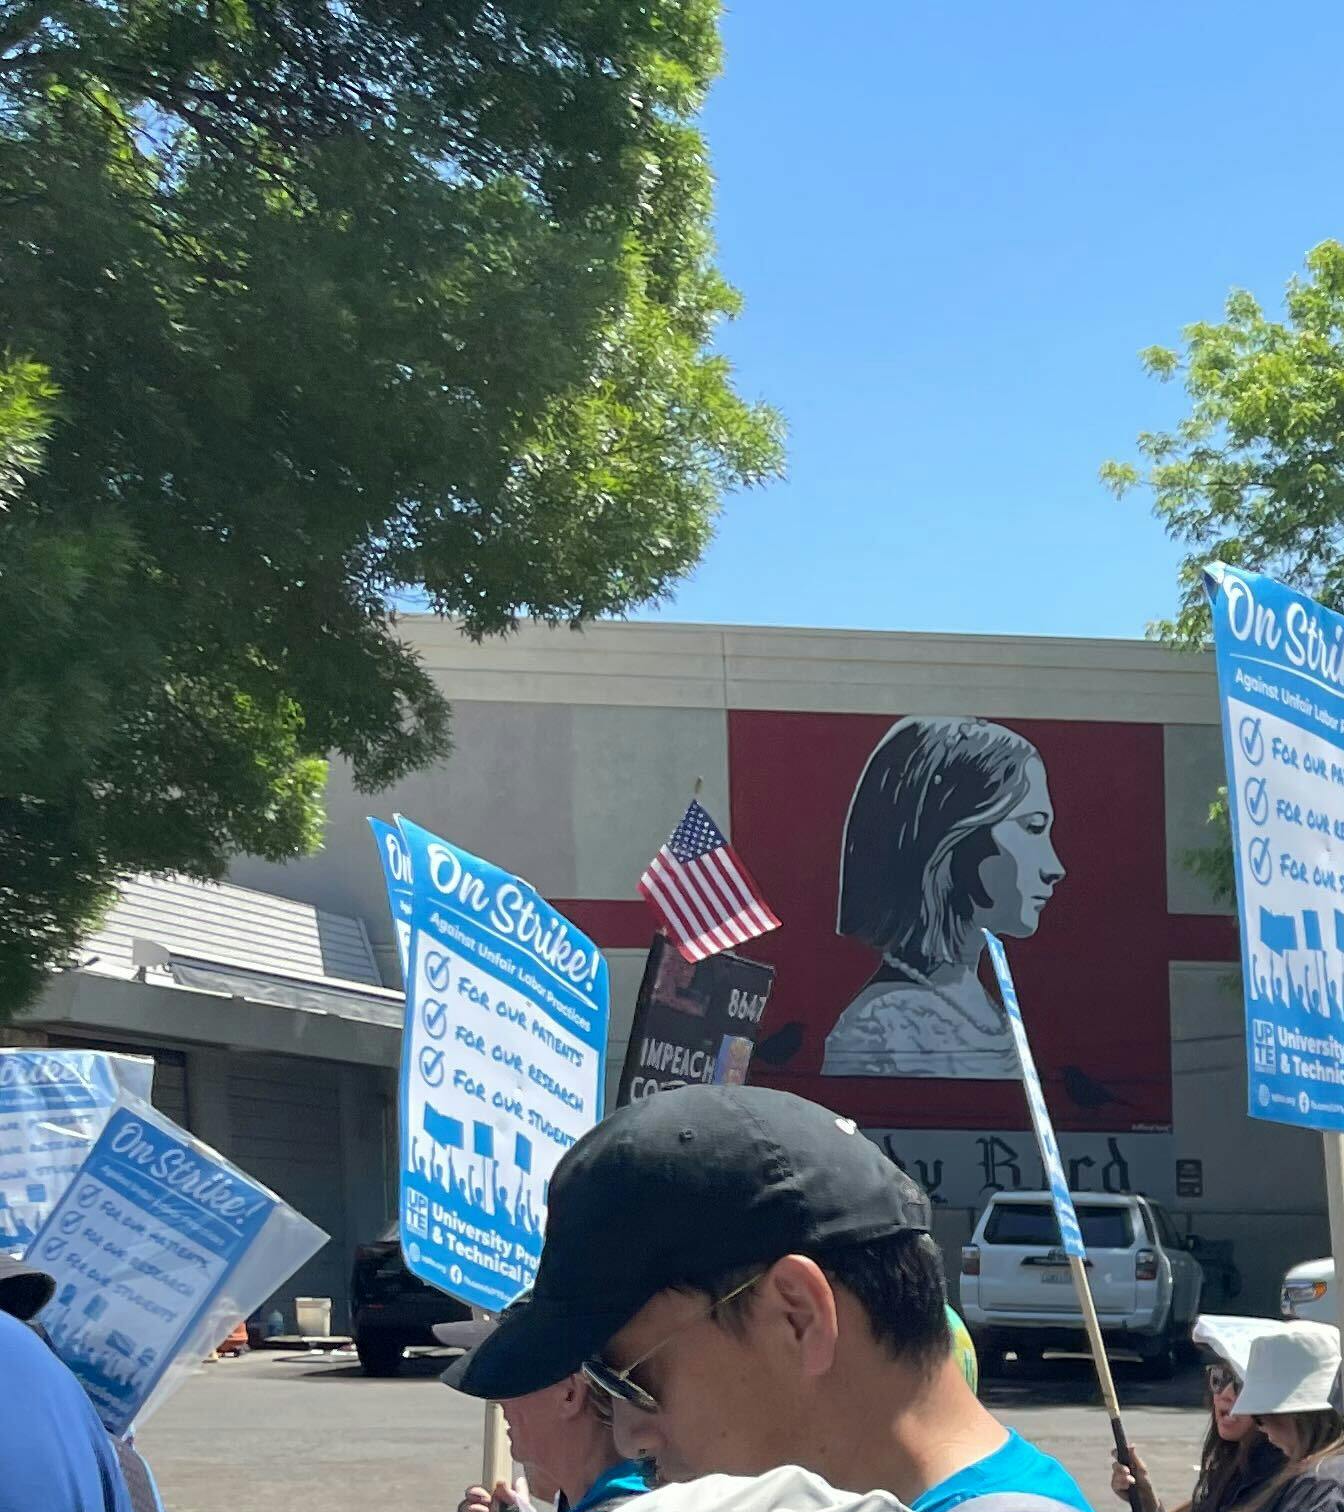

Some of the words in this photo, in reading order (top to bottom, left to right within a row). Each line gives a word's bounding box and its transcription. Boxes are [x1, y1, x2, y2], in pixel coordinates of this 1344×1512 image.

[1223, 574, 1282, 651] On
[1235, 668, 1280, 702] Against
[1281, 688, 1313, 717] Unfair
[1314, 704, 1339, 730] Labor
[1271, 736, 1300, 771] FOR
[1303, 752, 1329, 782] OUR
[1276, 799, 1303, 827] FOR
[1306, 810, 1331, 837] OUR
[1280, 853, 1308, 884] FOR
[1313, 864, 1338, 892] OUR
[426, 842, 490, 912] On
[489, 883, 600, 993] Strike!
[429, 912, 477, 951] Against
[477, 942, 517, 976] Unfair
[517, 966, 547, 997] Labor
[546, 991, 592, 1033] Practices
[456, 976, 491, 1012] FOR
[496, 1000, 529, 1033] OUR
[531, 1018, 585, 1068] PATIENTS
[454, 1025, 486, 1056] FOR
[491, 1044, 524, 1078] OUR
[527, 1063, 585, 1114] RESEARCH
[639, 1037, 716, 1085] IMPEACH
[1280, 1057, 1291, 1075] &
[453, 1068, 487, 1103] FOR
[491, 1091, 525, 1122] OUR
[111, 1121, 156, 1166] On
[150, 1148, 267, 1225] Strike!
[975, 1135, 1130, 1195] Brd
[431, 1226, 444, 1246] &
[447, 1233, 523, 1284] Technical
[432, 1202, 513, 1260] University
